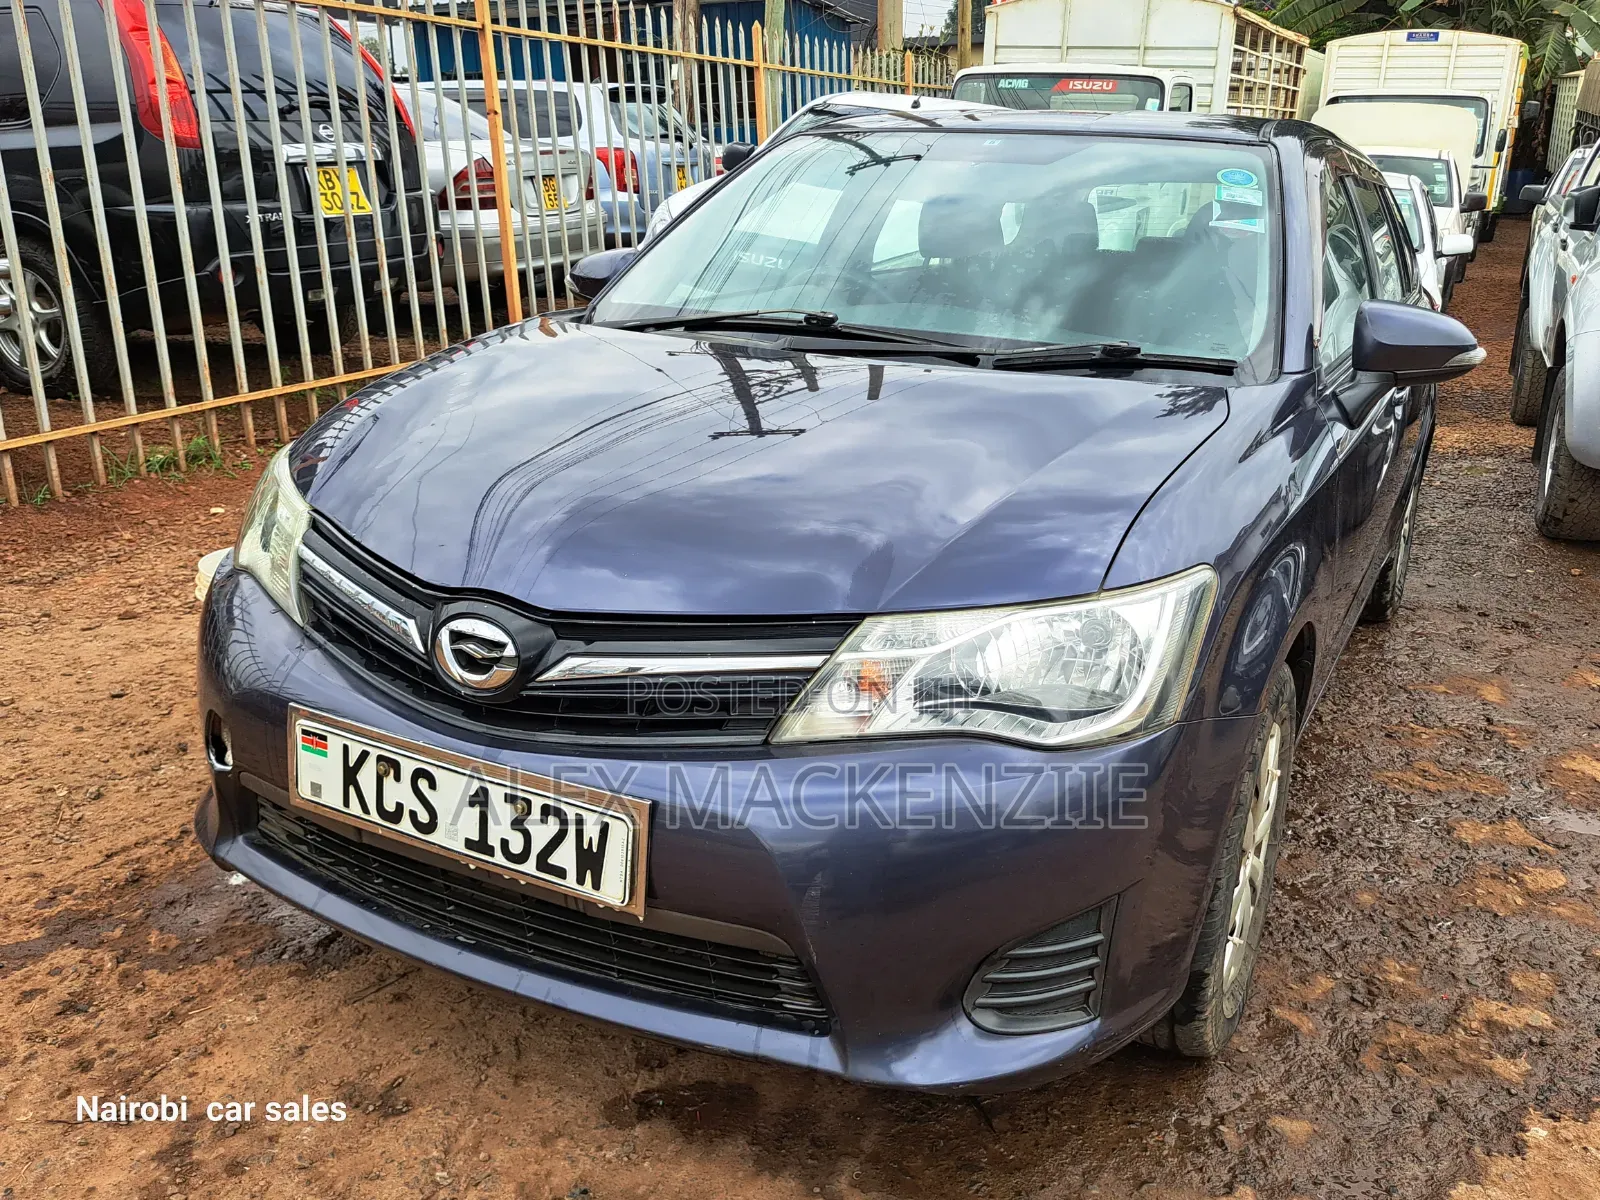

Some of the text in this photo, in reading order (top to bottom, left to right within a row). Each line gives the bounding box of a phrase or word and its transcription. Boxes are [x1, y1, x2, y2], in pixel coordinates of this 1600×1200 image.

[997, 79, 1029, 89] ACMG
[1068, 80, 1113, 90] ISUZU
[342, 742, 438, 836] KCS
[464, 785, 611, 892] 132W
